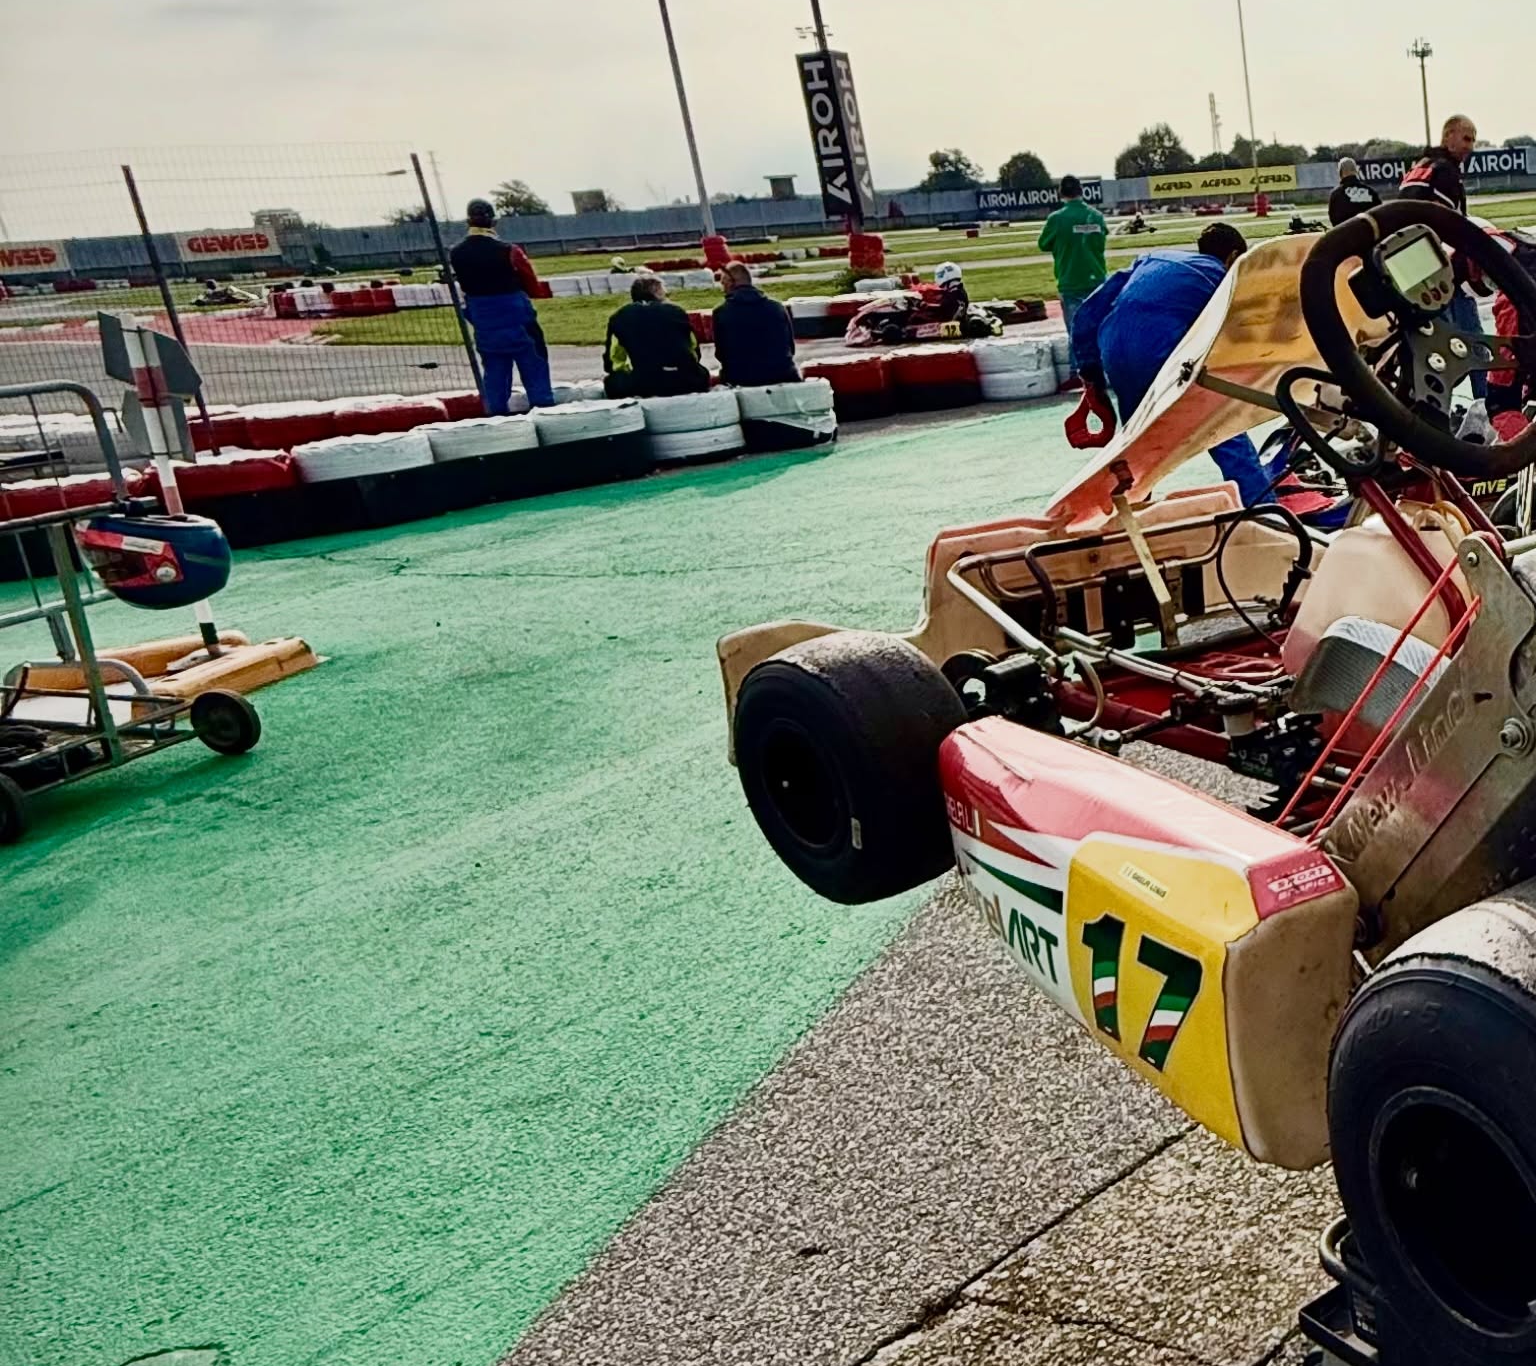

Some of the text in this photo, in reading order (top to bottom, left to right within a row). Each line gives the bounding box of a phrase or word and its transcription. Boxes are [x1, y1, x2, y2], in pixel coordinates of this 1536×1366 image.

[803, 60, 852, 204] AIROH
[836, 59, 873, 201] AIROH
[979, 189, 1059, 208] AIROH AIROH
[1467, 152, 1526, 174] AIROH
[1081, 912, 1204, 1073] 17
